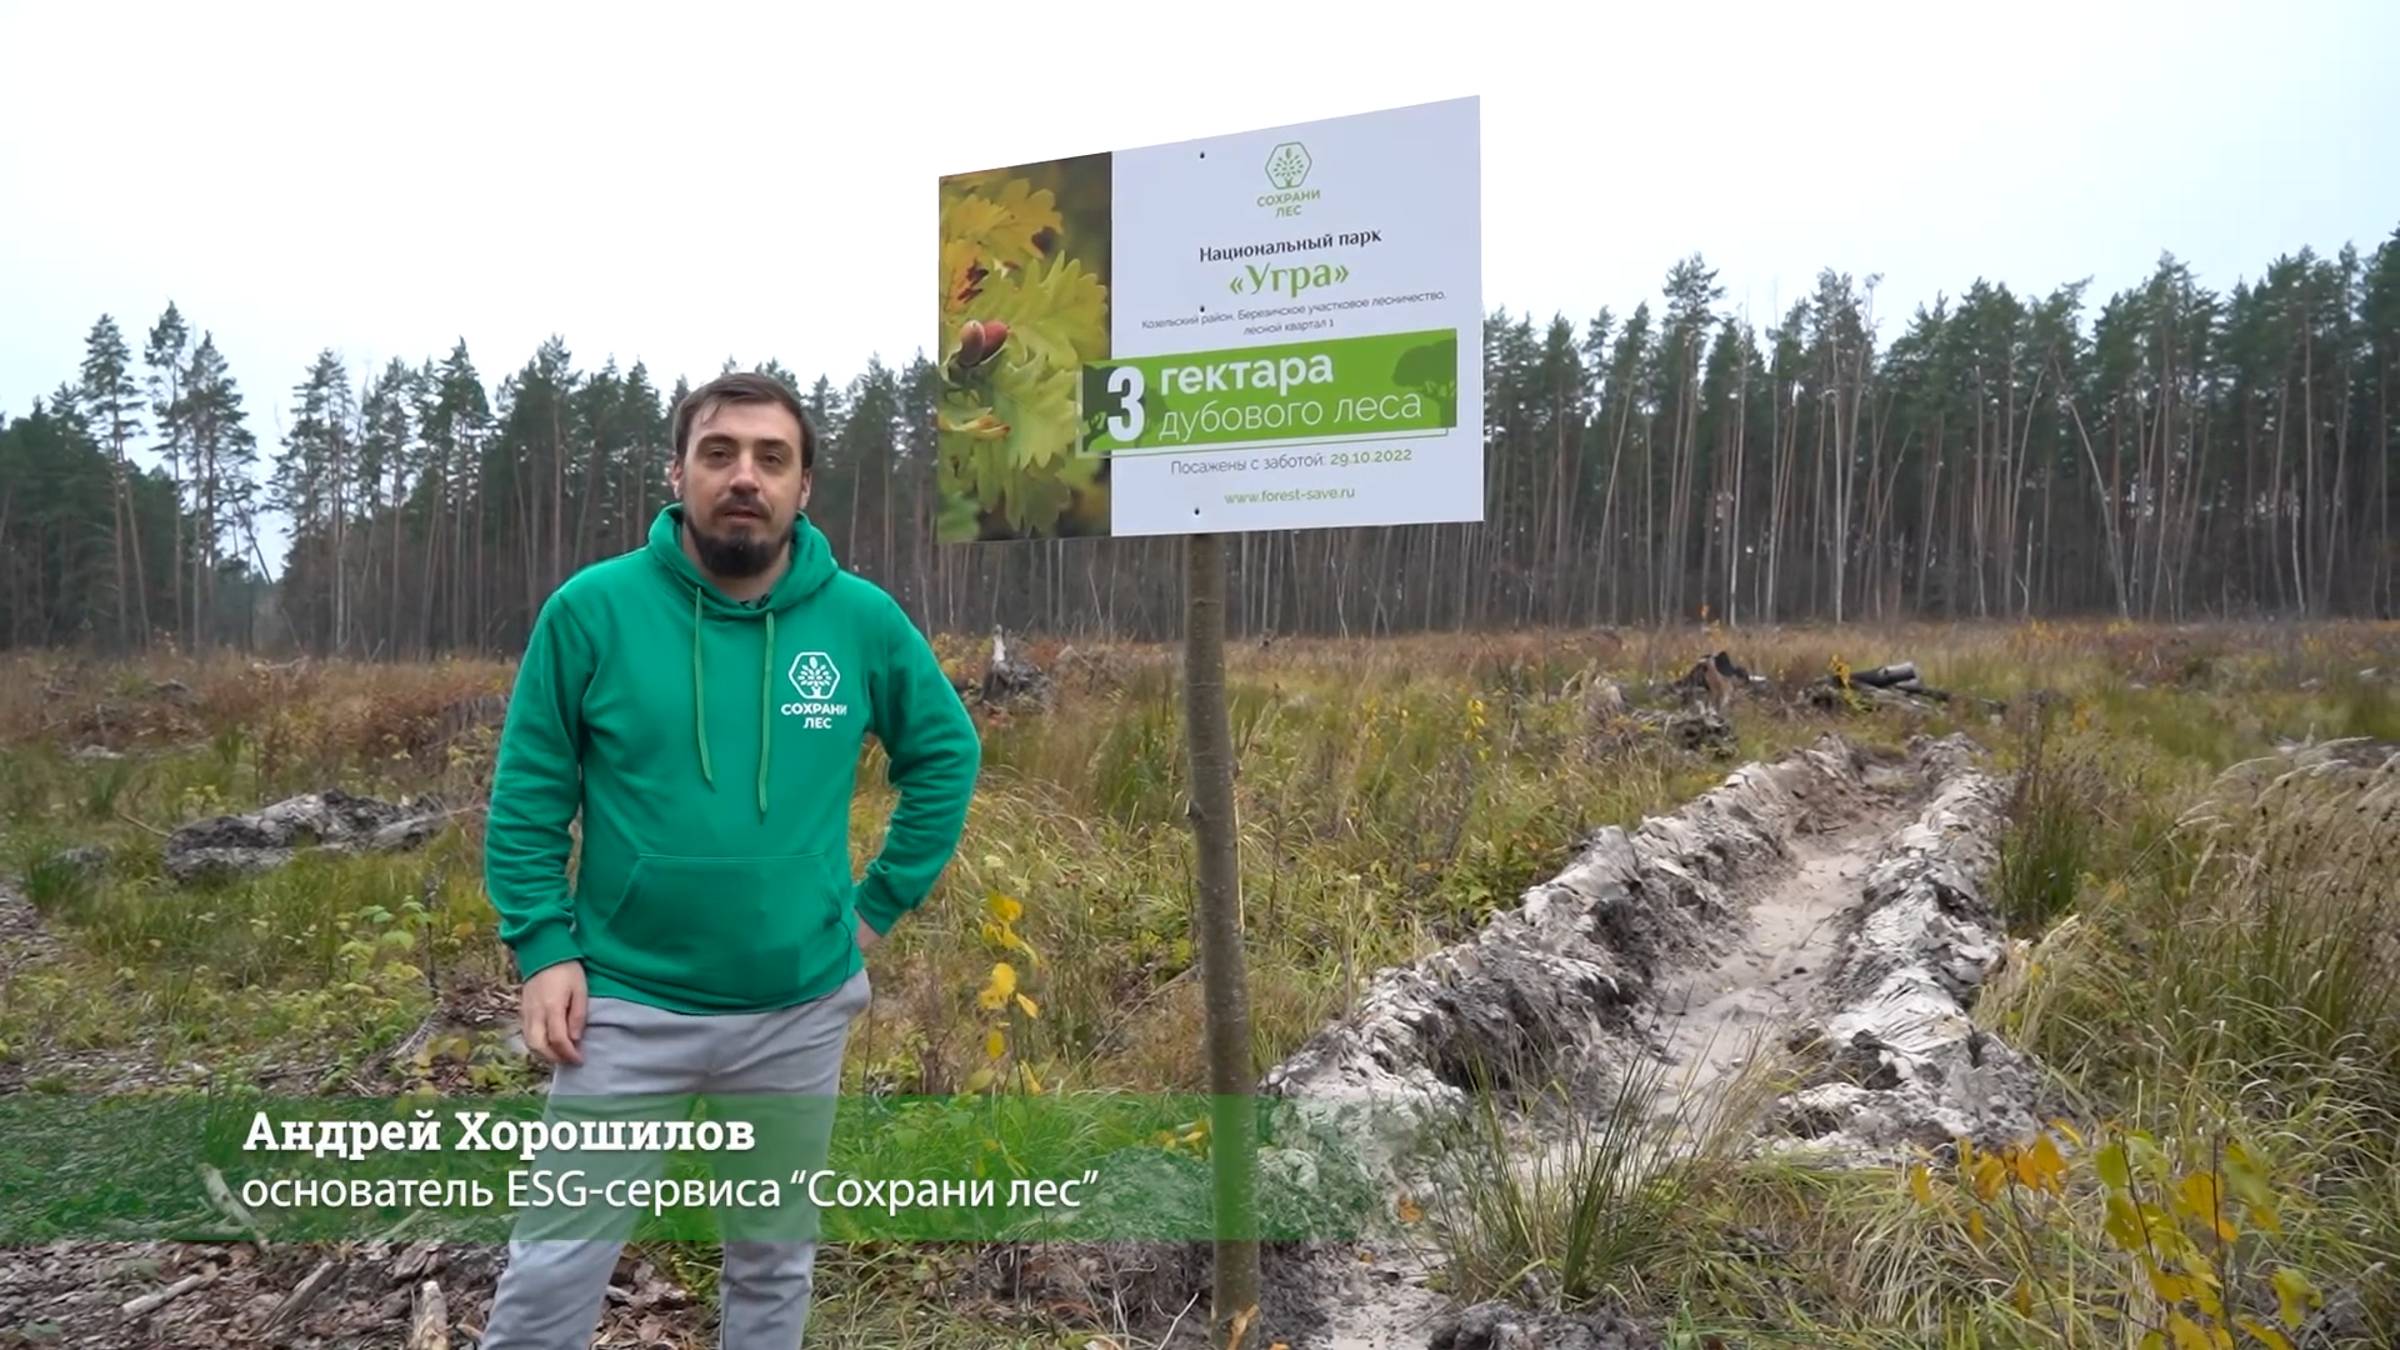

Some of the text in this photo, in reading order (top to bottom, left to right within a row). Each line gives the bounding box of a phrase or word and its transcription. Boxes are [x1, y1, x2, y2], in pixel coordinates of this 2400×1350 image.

[1257, 189, 1321, 208] СОХРАНИ
[1275, 205, 1302, 218] ЛЕС
[1199, 229, 1382, 263] Национальный парк
[1229, 262, 1349, 298] «Угра»
[1142, 315, 1199, 329] Козельский
[1308, 299, 1369, 315] участковое
[1244, 322, 1282, 335] лесной
[1284, 319, 1327, 333] квартал
[1160, 354, 1334, 396] гектара
[1107, 366, 1145, 442] 3
[1159, 392, 1422, 443] дубового леса
[1170, 460, 1247, 475] Посажены
[1251, 459, 1260, 470] с
[1330, 449, 1413, 467] 29.10.2022
[1224, 487, 1355, 504] www.forest-save.ru
[781, 703, 848, 716] СОХРАНИ
[802, 717, 832, 729] ЛЕС
